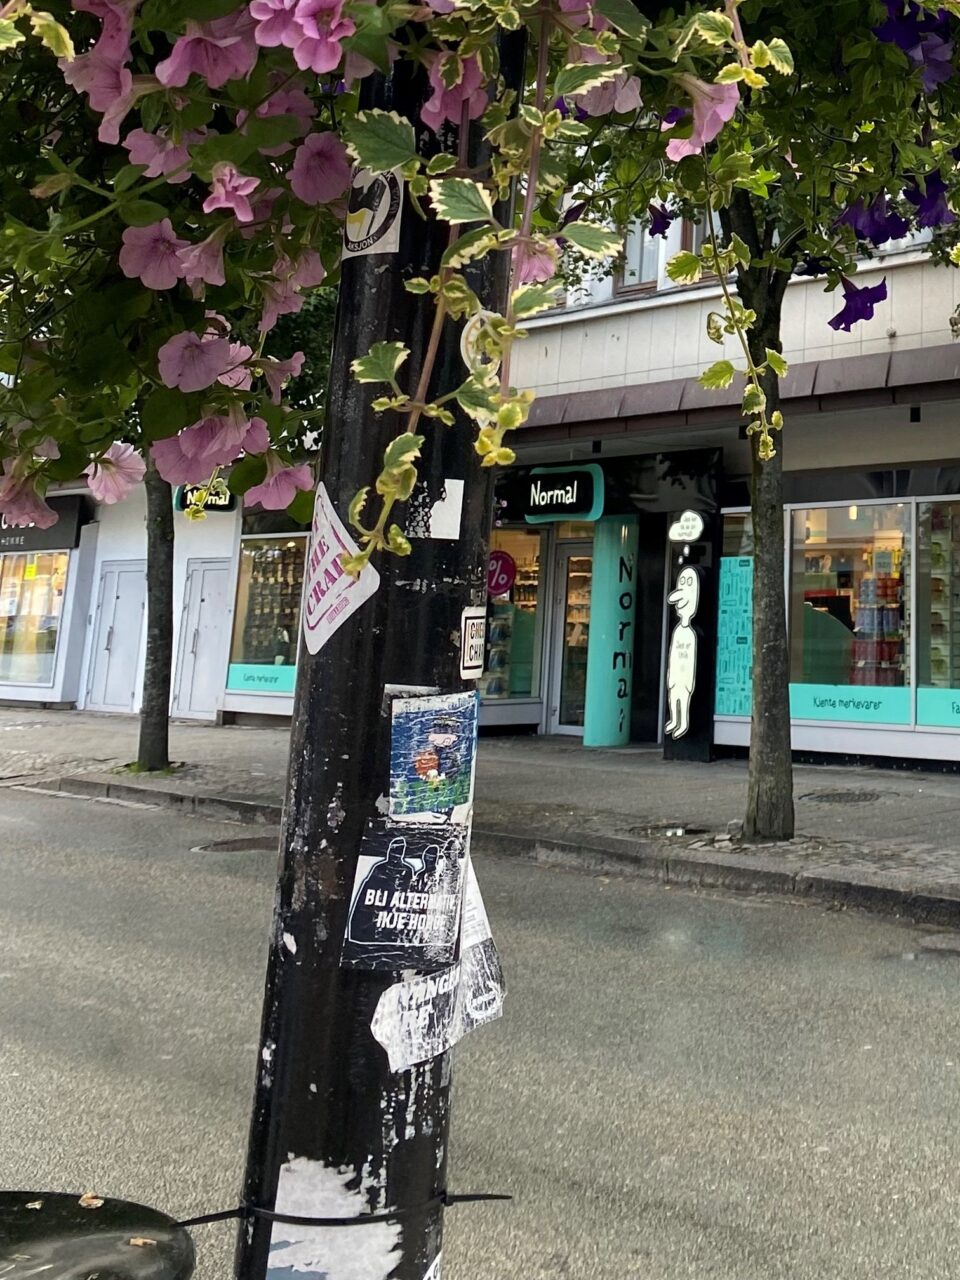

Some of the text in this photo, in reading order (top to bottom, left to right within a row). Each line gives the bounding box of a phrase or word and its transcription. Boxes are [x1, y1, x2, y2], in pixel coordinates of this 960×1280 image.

[187, 489, 231, 505] Nmal
[530, 480, 578, 507] Normal
[612, 554, 635, 734] Normal
[838, 697, 883, 711] merkevarer
[364, 888, 389, 907] BLI
